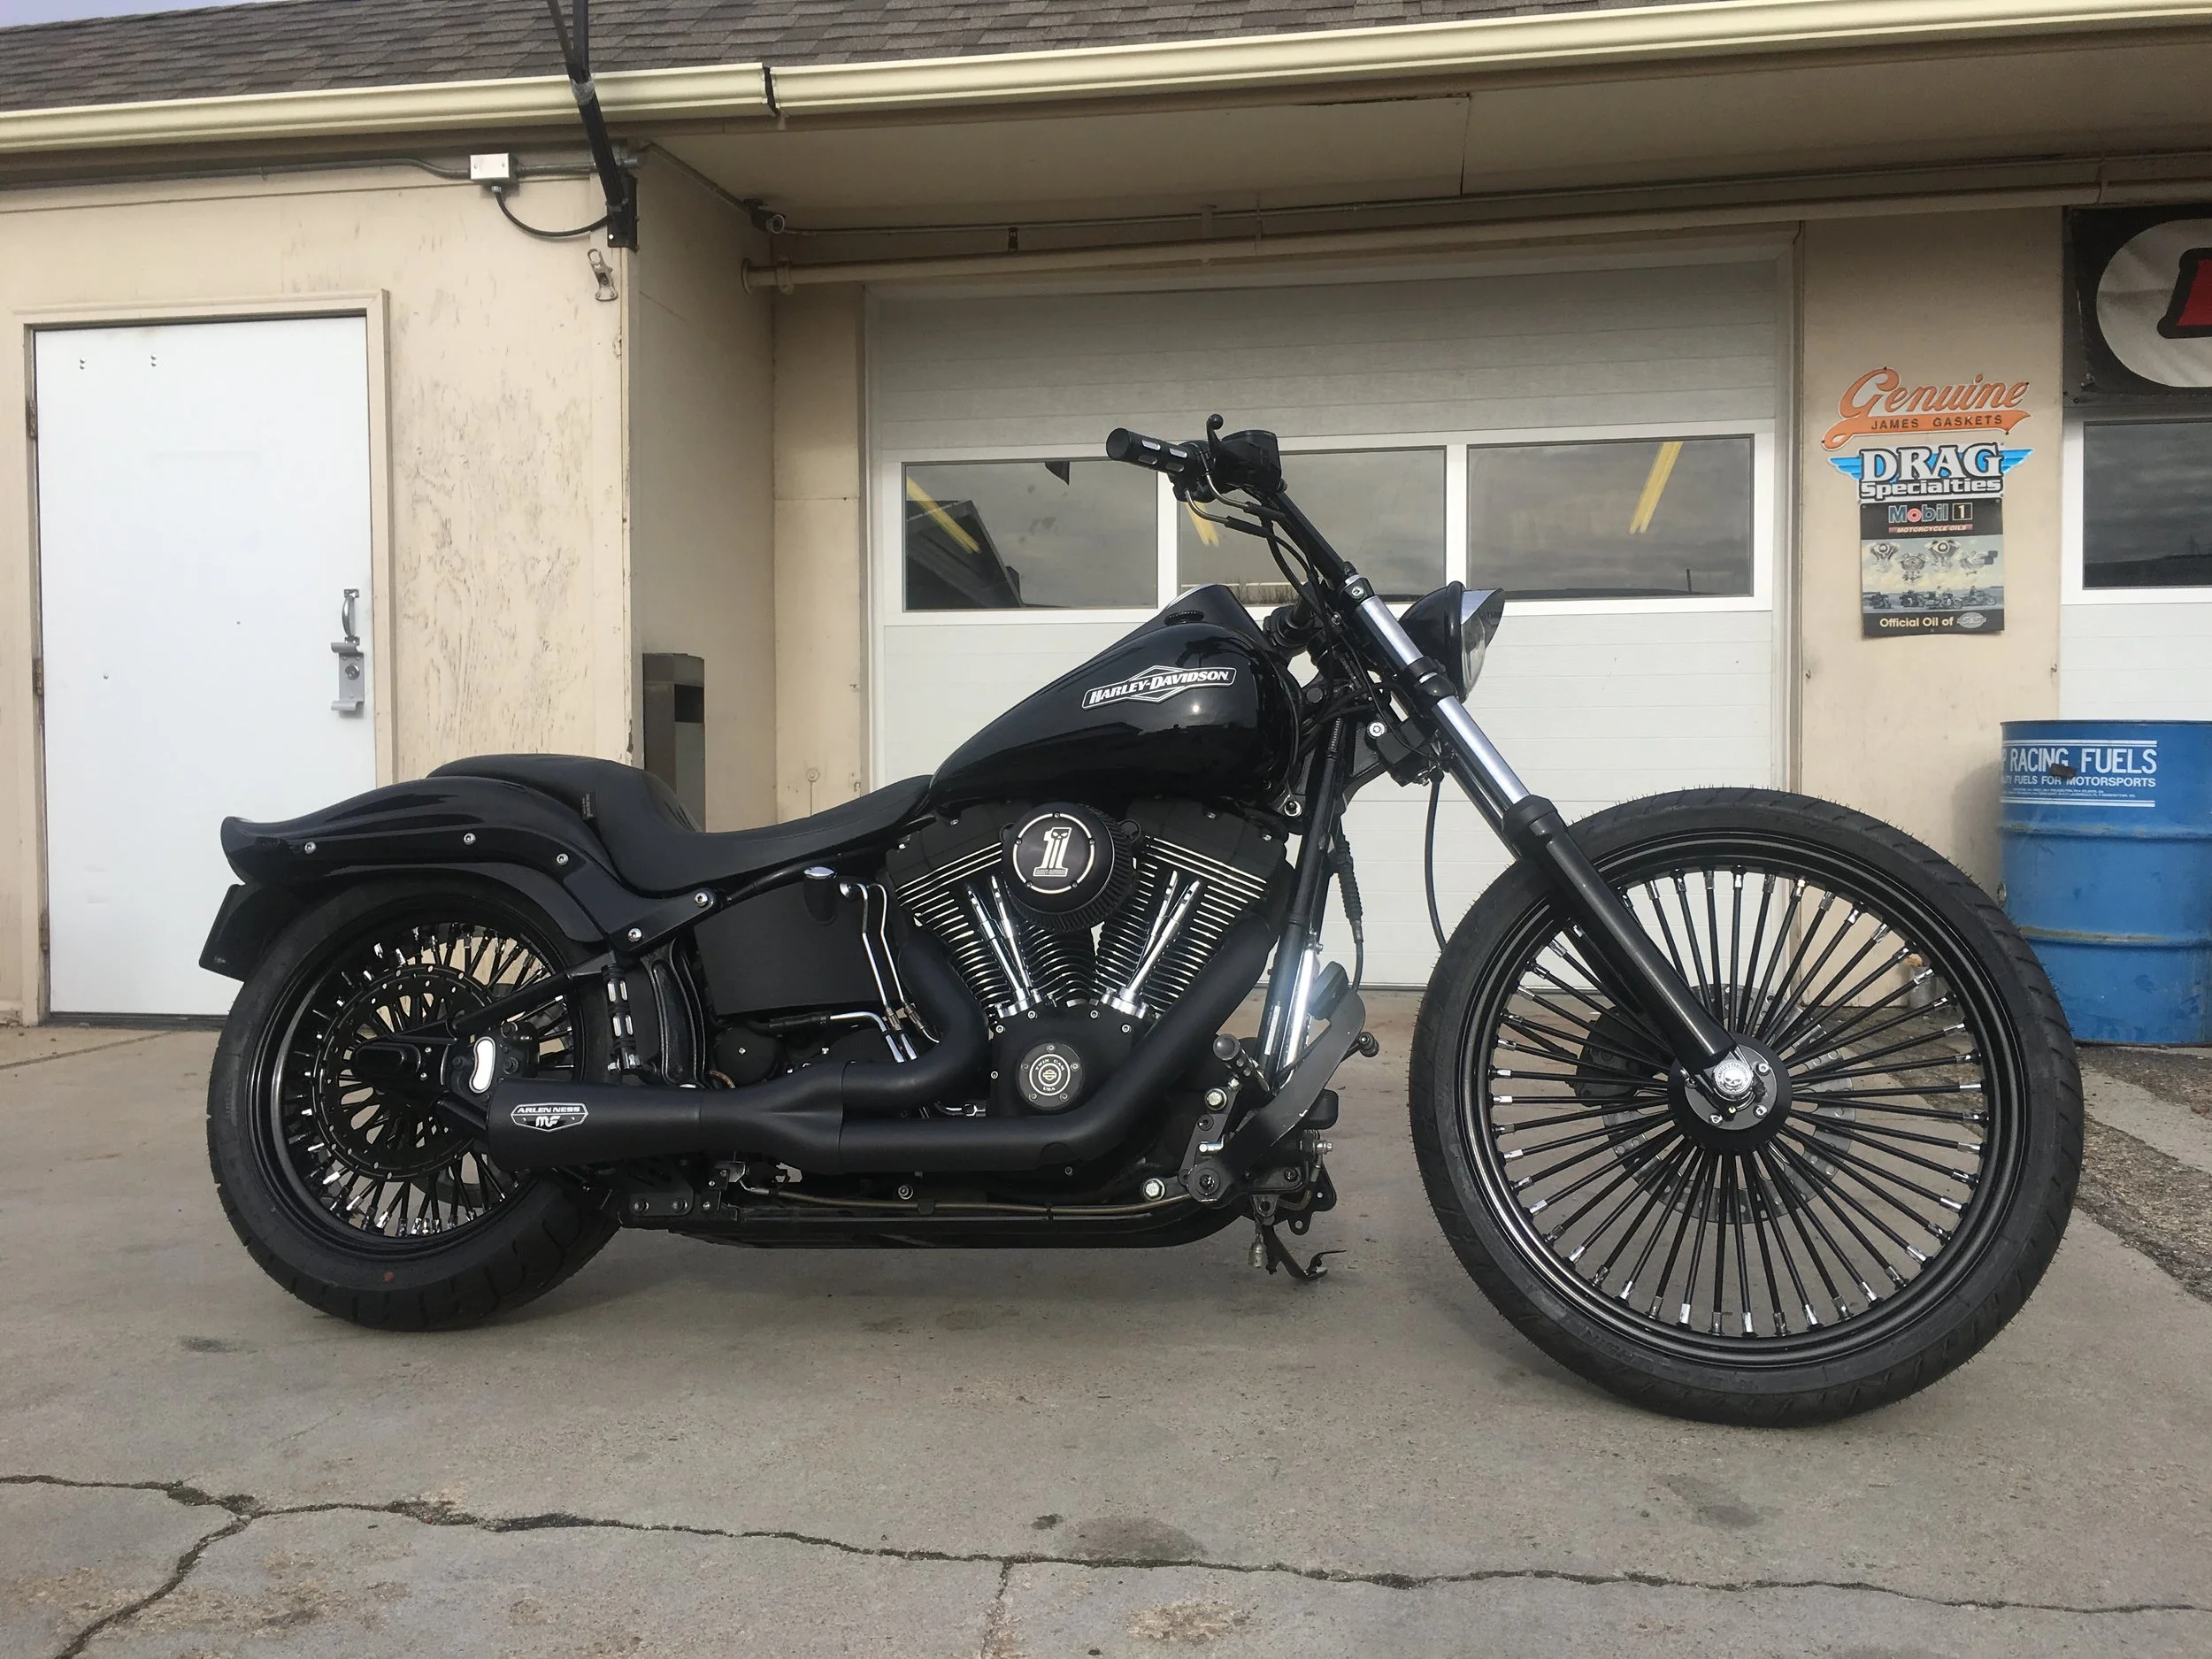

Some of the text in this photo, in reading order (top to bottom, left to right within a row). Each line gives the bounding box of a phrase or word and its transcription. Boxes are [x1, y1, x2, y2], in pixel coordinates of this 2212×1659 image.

[1839, 367, 2029, 419] Genuine
[1871, 414, 2002, 430] JAMES GASKETS
[1859, 442, 2003, 483] DRAG
[1860, 478, 2002, 499] Specialties
[1888, 503, 1949, 523] Mobil
[1879, 618, 1919, 628] Official
[1922, 617, 1939, 627] Oil
[1941, 616, 1955, 626] of
[1088, 671, 1228, 705] HARLEY-DAVIDSON
[2009, 748, 2069, 772] RACING
[2081, 748, 2157, 774] FUELS
[2014, 775, 2038, 785] FUELS
[2041, 775, 2062, 786] FOR
[2066, 776, 2156, 787] MOTORSPORTS
